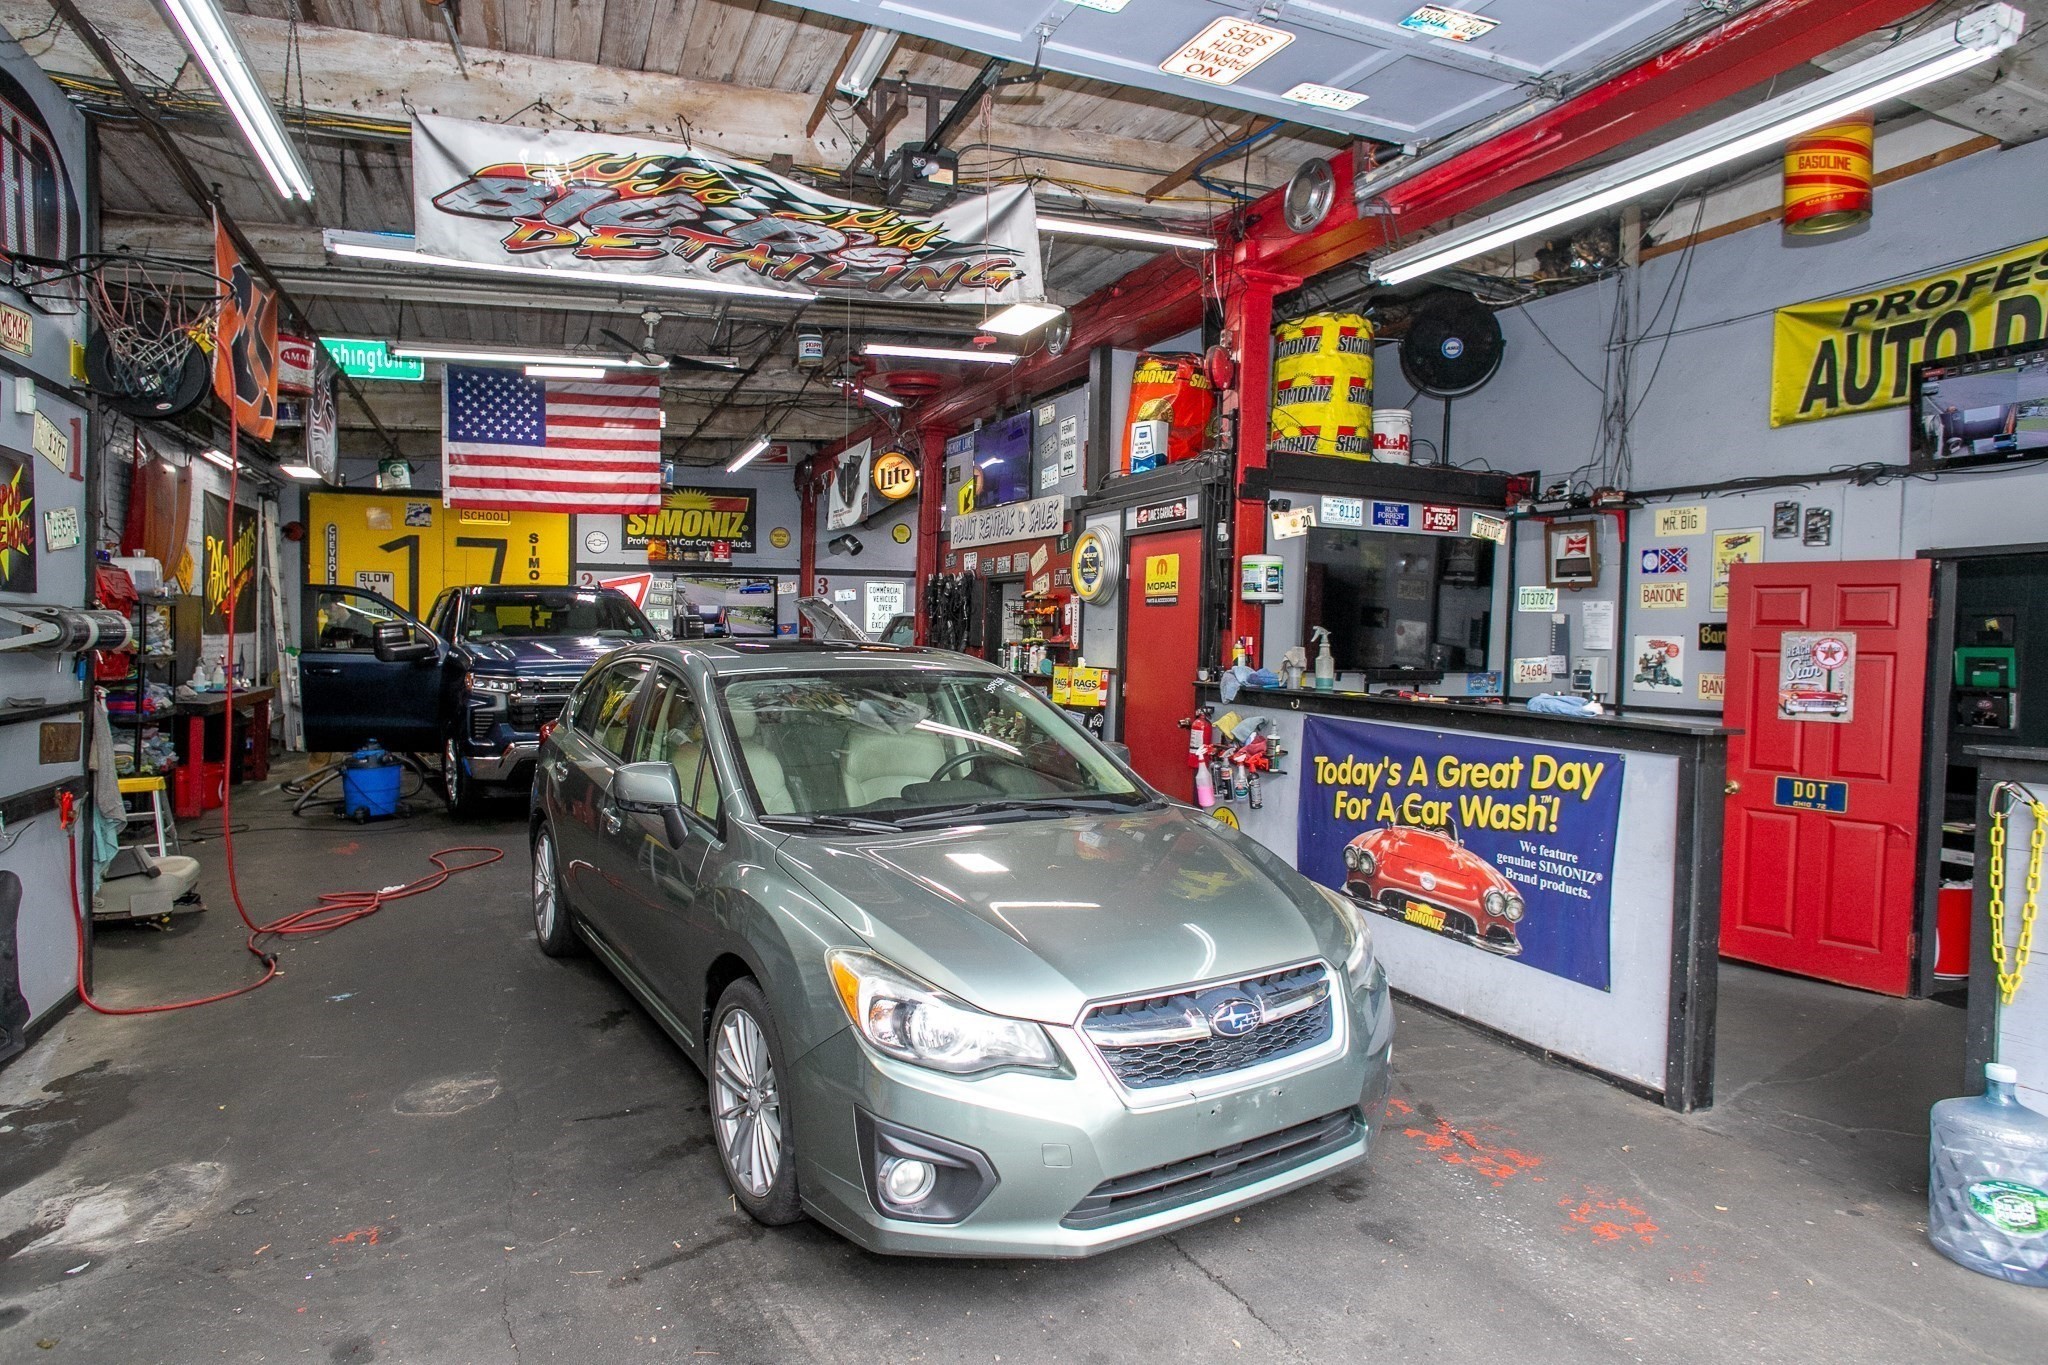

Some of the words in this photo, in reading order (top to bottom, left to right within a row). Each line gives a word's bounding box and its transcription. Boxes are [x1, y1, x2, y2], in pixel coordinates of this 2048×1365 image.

[1223, 26, 1273, 47] SIDES
[1209, 39, 1254, 57] BOTH
[1184, 48, 1248, 71] PARKING
[1186, 63, 1221, 78] NO
[1798, 155, 1851, 171] GASOLINE
[432, 175, 707, 229] BIG
[500, 217, 1025, 292] DETAILING
[332, 343, 402, 374] shington
[1800, 310, 1971, 413] AUTO
[1134, 371, 1177, 384] SIMONIZ
[1277, 385, 1333, 406] SIMONIZ
[69, 417, 84, 482] 1
[1061, 436, 1076, 447] PARKING
[1064, 450, 1073, 460] AREA
[880, 468, 910, 490] Lite
[464, 511, 507, 521] SCHOOL
[1160, 505, 1174, 519] GARAGE
[1339, 505, 1360, 518] 8118
[1426, 512, 1456, 526] D-45359
[952, 515, 977, 544] ADULT
[979, 508, 1015, 539] RENTALS
[1028, 500, 1059, 533] SALES
[1663, 516, 1678, 530] MR.
[1681, 515, 1697, 529] BIG
[680, 538, 693, 546] Car
[328, 526, 336, 585] CHEVROLE
[529, 533, 540, 581] SIMO
[359, 573, 390, 583] SLOW
[818, 577, 828, 595] 3
[1147, 581, 1177, 590] MOPAR
[869, 586, 901, 594] COMMERCIAL
[873, 595, 897, 603] VEHICLES
[1787, 645, 1811, 658] REACH
[1521, 664, 1547, 677] 24684
[1055, 677, 1067, 686] RAGS
[1073, 679, 1097, 688] RAGS
[1314, 754, 1401, 794] Today's
[1407, 756, 1429, 787] A
[1437, 755, 1524, 789] Great
[1530, 754, 1604, 801] Day
[1793, 781, 1829, 800] DOT
[1334, 791, 1371, 820] For
[1376, 791, 1397, 823] A
[1403, 793, 1452, 826] Car
[1519, 840, 1537, 854] We
[1539, 844, 1578, 863] feature
[1497, 853, 1537, 869] genuine
[1505, 867, 1537, 885] Brand
[1540, 878, 1592, 900] products.
[1404, 906, 1445, 931] SIMONIZ
